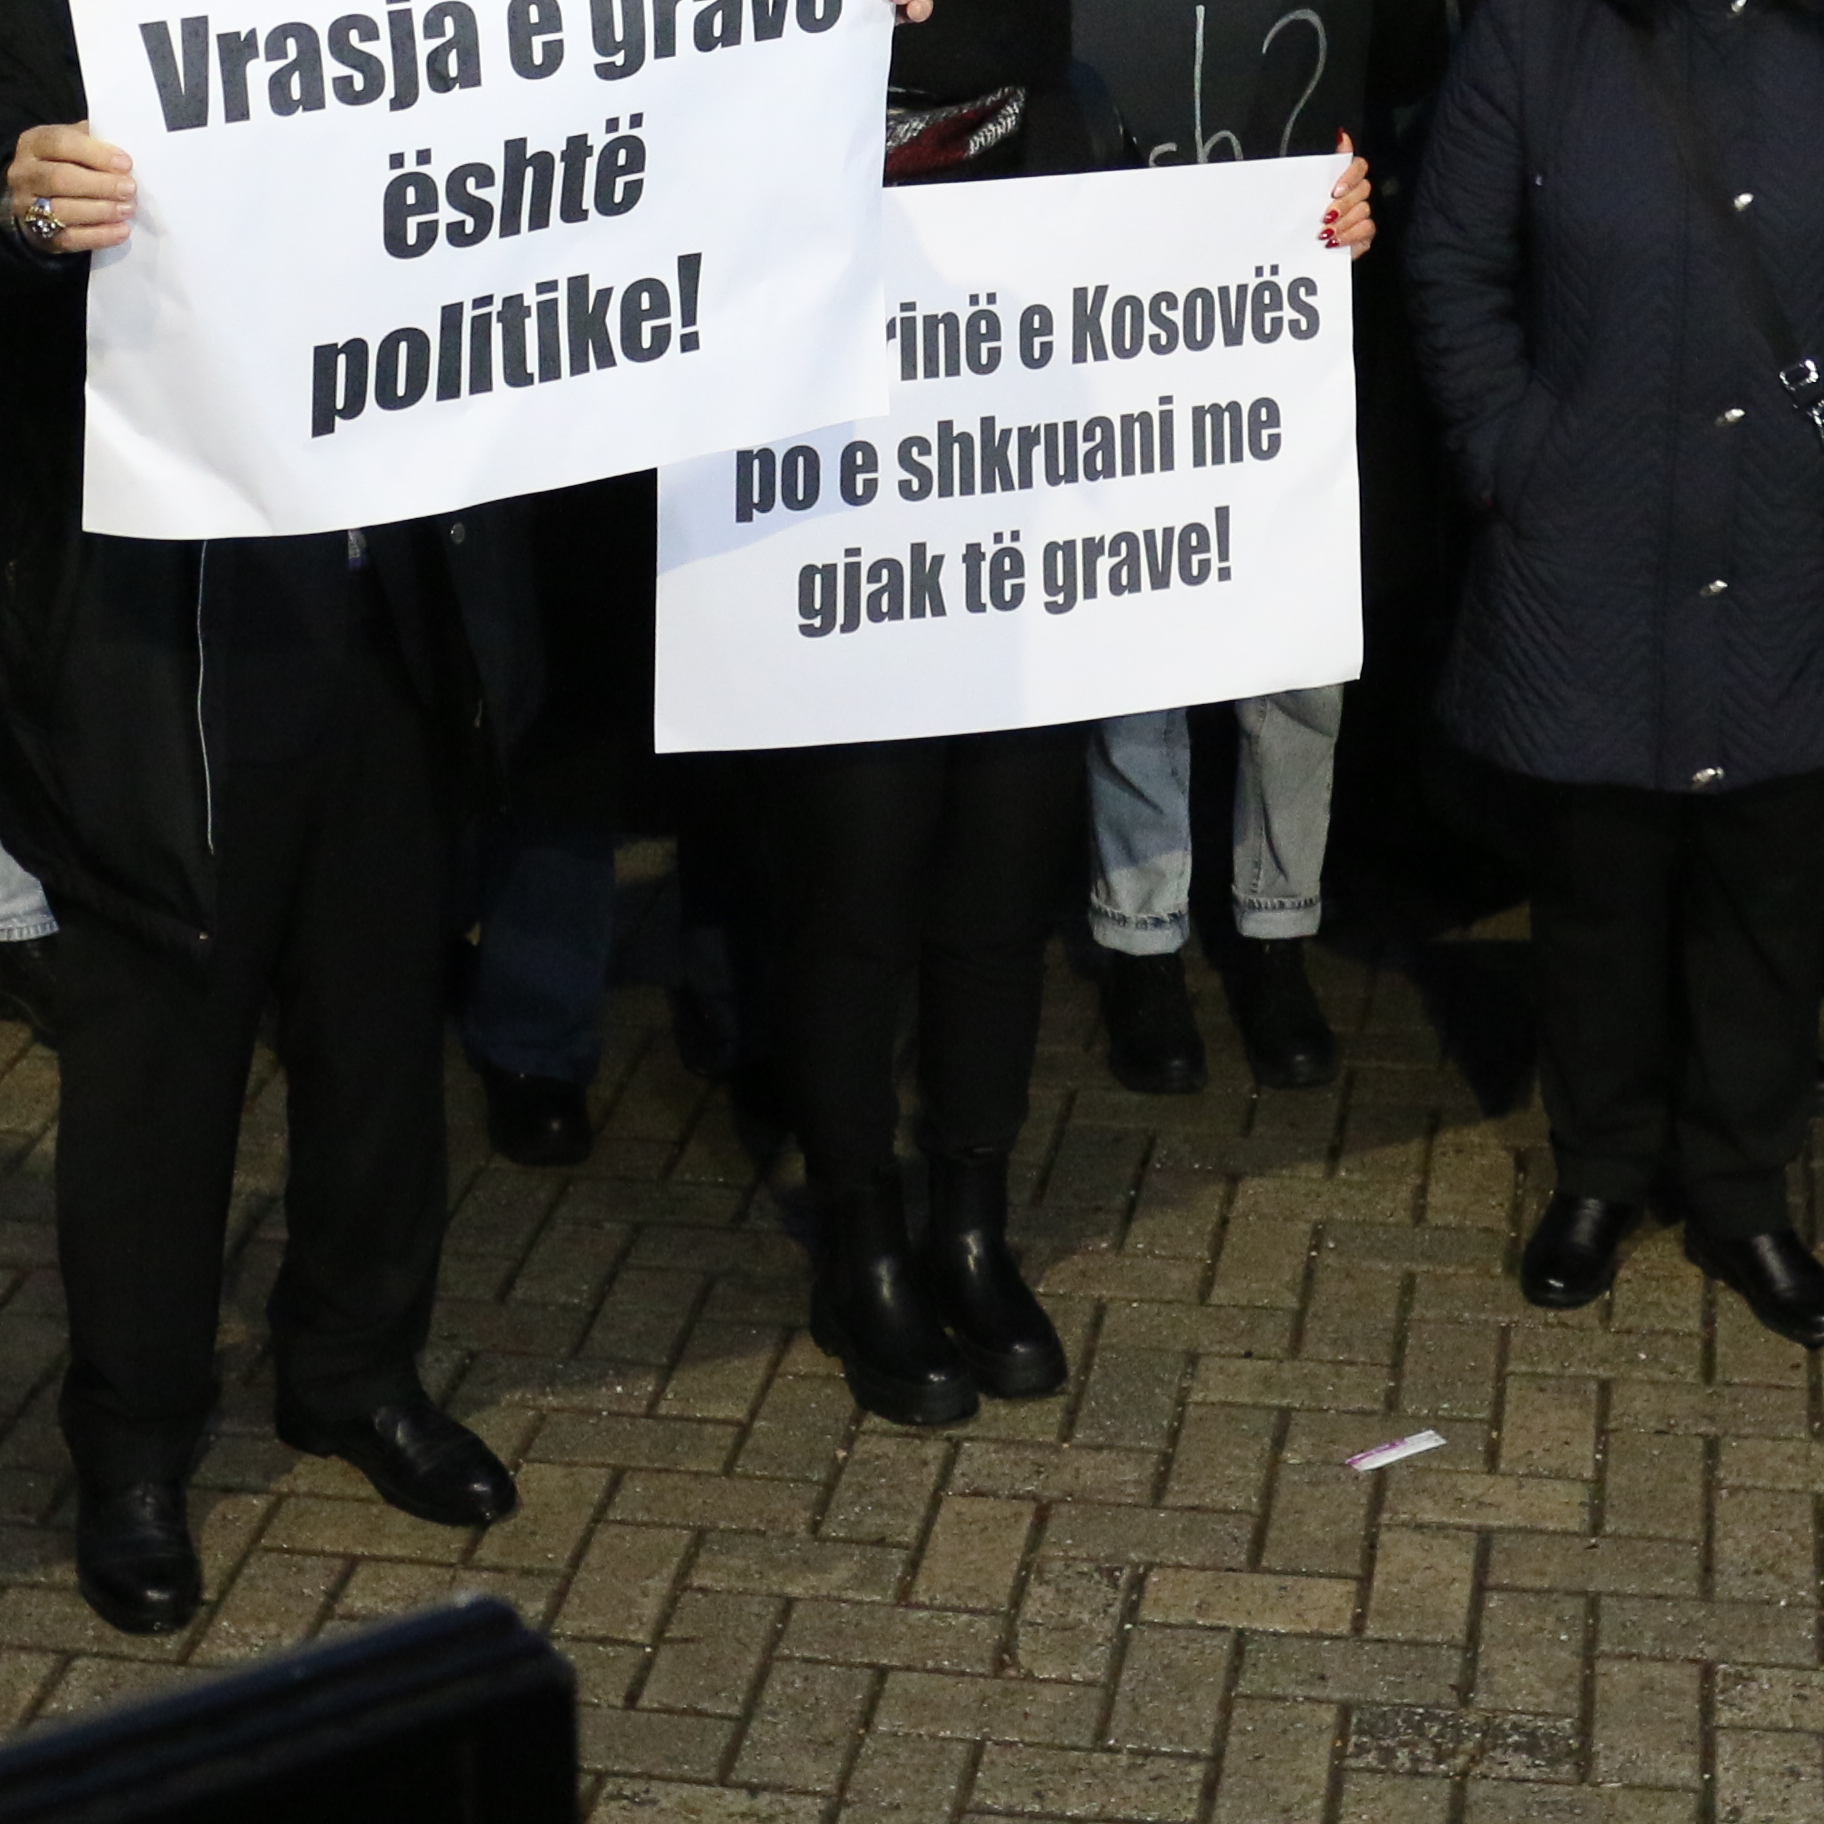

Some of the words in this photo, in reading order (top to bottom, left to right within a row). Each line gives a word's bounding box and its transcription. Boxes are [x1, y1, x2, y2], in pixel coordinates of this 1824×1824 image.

[384, 113, 645, 258] është
[312, 253, 701, 437] politike!
[1020, 305, 1052, 369] e
[1073, 265, 1318, 363] Kosovës
[736, 446, 820, 522] po
[840, 441, 877, 506] e
[898, 396, 1173, 501] shkruani
[1193, 398, 1280, 466] me
[799, 543, 945, 637] gjak
[963, 531, 1024, 612] të
[1044, 507, 1230, 613] grave!
